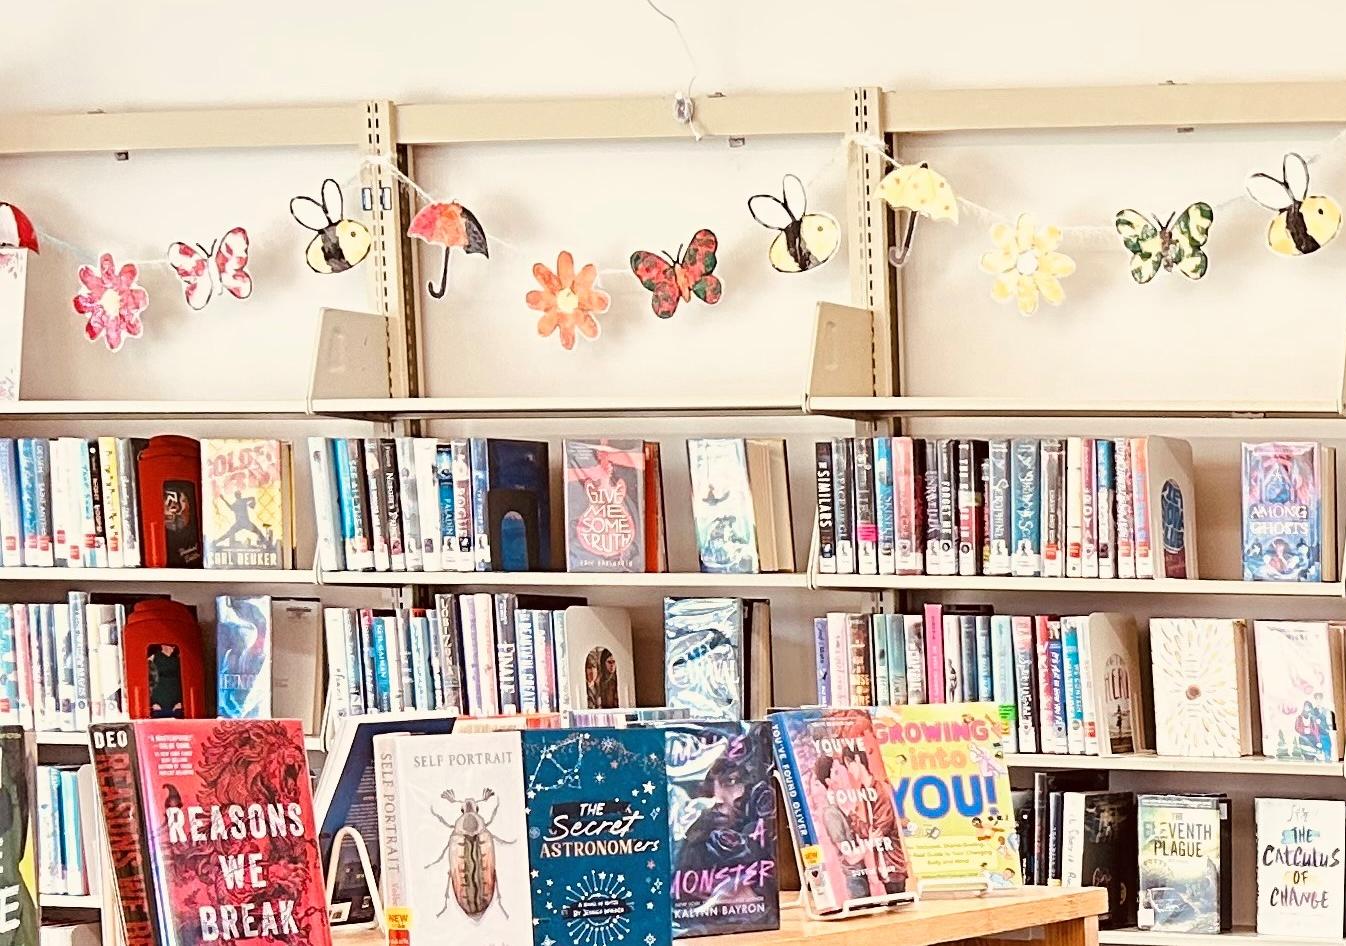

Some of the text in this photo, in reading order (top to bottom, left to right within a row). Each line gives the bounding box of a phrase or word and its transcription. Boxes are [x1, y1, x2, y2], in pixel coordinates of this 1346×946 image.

[586, 483, 626, 504] GIVE
[817, 470, 831, 528] SIMILARS
[443, 498, 454, 535] PALADIN
[585, 504, 626, 518] ME
[1250, 506, 1308, 520] AMONG
[582, 516, 630, 534] SOME
[583, 531, 632, 554] TRUTH
[237, 551, 278, 566] DEUKER
[498, 641, 515, 694] FINALE
[94, 731, 128, 748] DEO
[874, 719, 989, 744] GROWING
[813, 737, 865, 753] YOU'VE
[414, 752, 512, 768] SELF PORTRAIT
[911, 747, 967, 770] into
[772, 724, 809, 837] YOU'VE FOUND OLIVER
[826, 787, 878, 805] FOUND
[888, 775, 1000, 819] YOU!
[96, 753, 141, 871] REASONS
[381, 754, 400, 874] SELF PORTRAIT
[580, 803, 606, 816] THE
[167, 803, 304, 843] REASONS
[544, 812, 644, 842] Secret
[749, 818, 766, 848] A
[1144, 822, 1212, 841] ELEVENTH
[1291, 826, 1313, 842] THE
[1154, 840, 1203, 857] PLAGUE
[219, 853, 266, 889] WE
[1293, 871, 1308, 885] OF
[1270, 887, 1329, 908] CHANGE
[722, 903, 765, 916] BAYRON
[200, 900, 299, 941] BREAK
